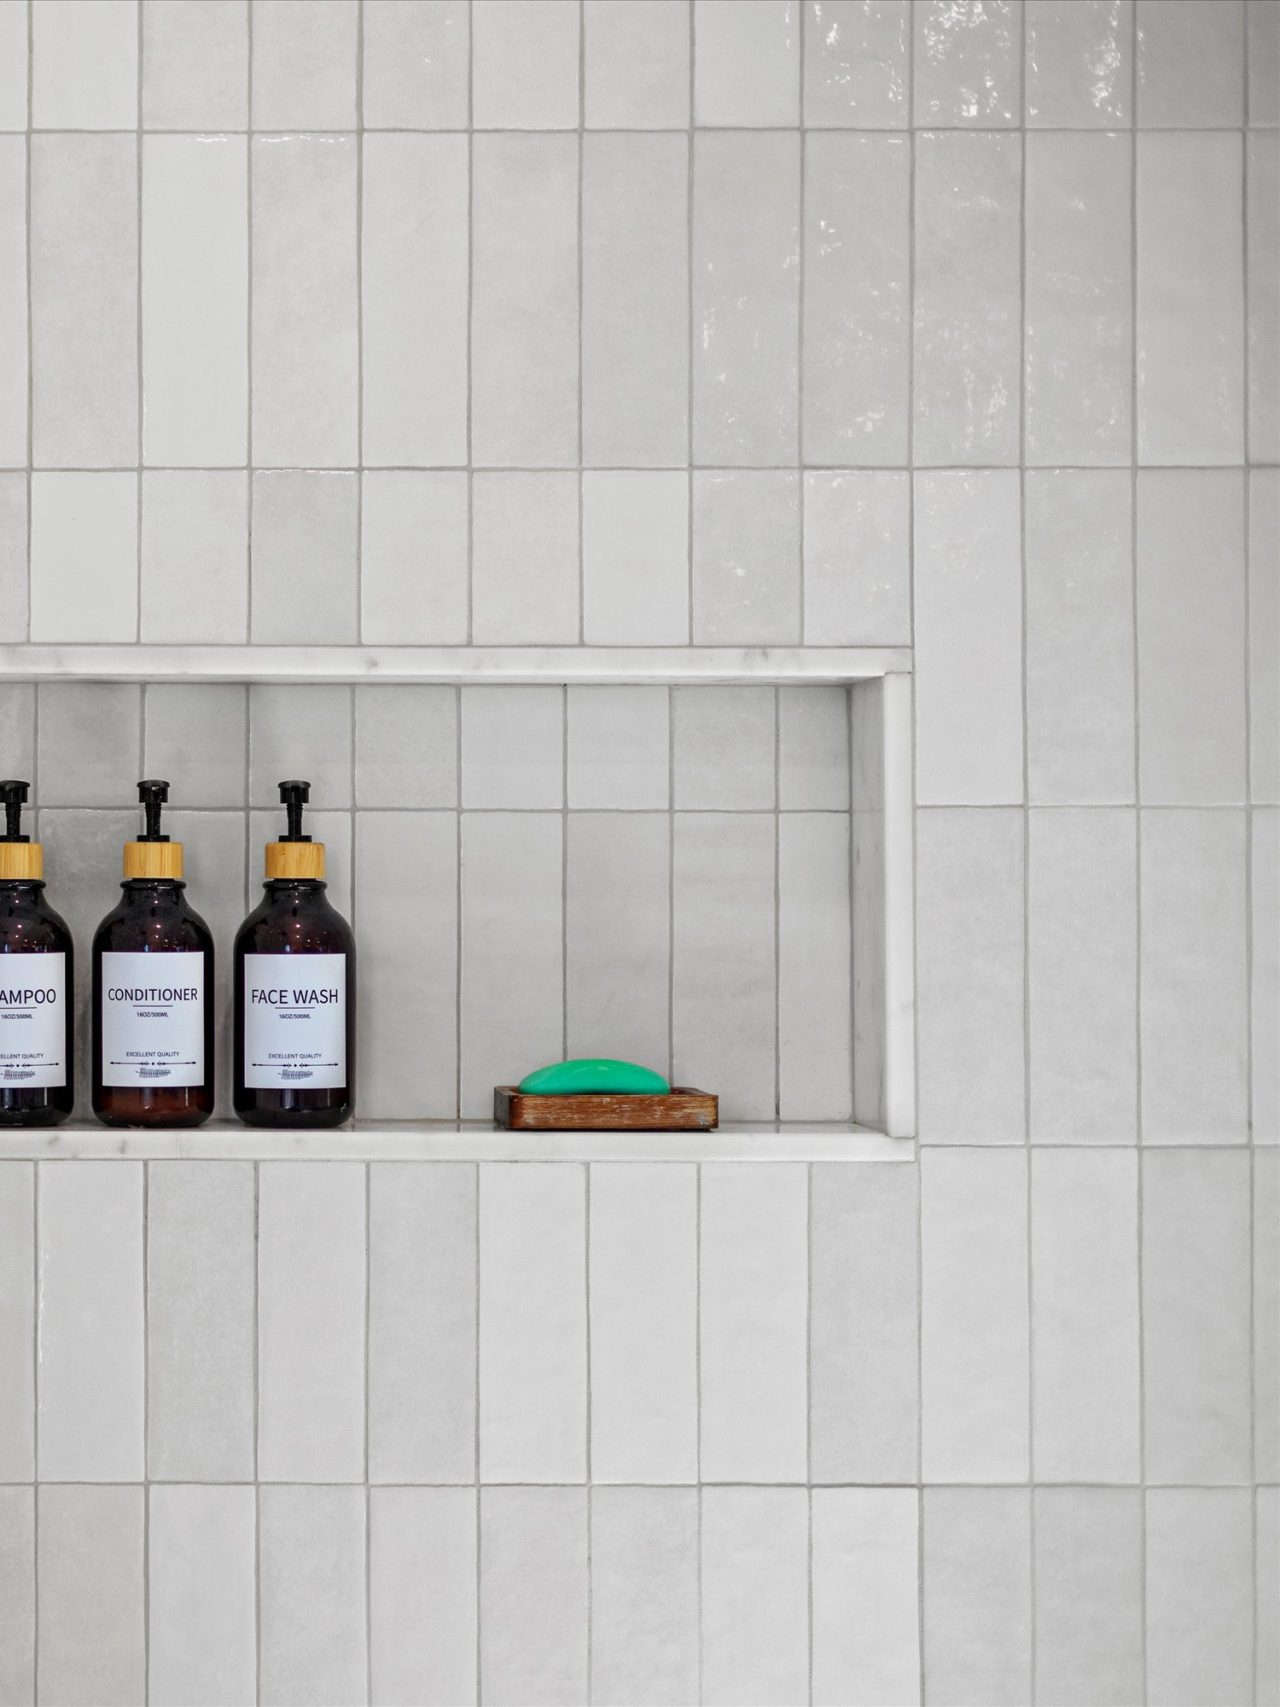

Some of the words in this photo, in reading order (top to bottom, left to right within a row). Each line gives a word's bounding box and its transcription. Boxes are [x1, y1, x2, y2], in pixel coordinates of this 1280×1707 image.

[108, 987, 198, 1002] CONDITIONER
[251, 988, 289, 1004] FACE
[292, 988, 339, 1004] WASH
